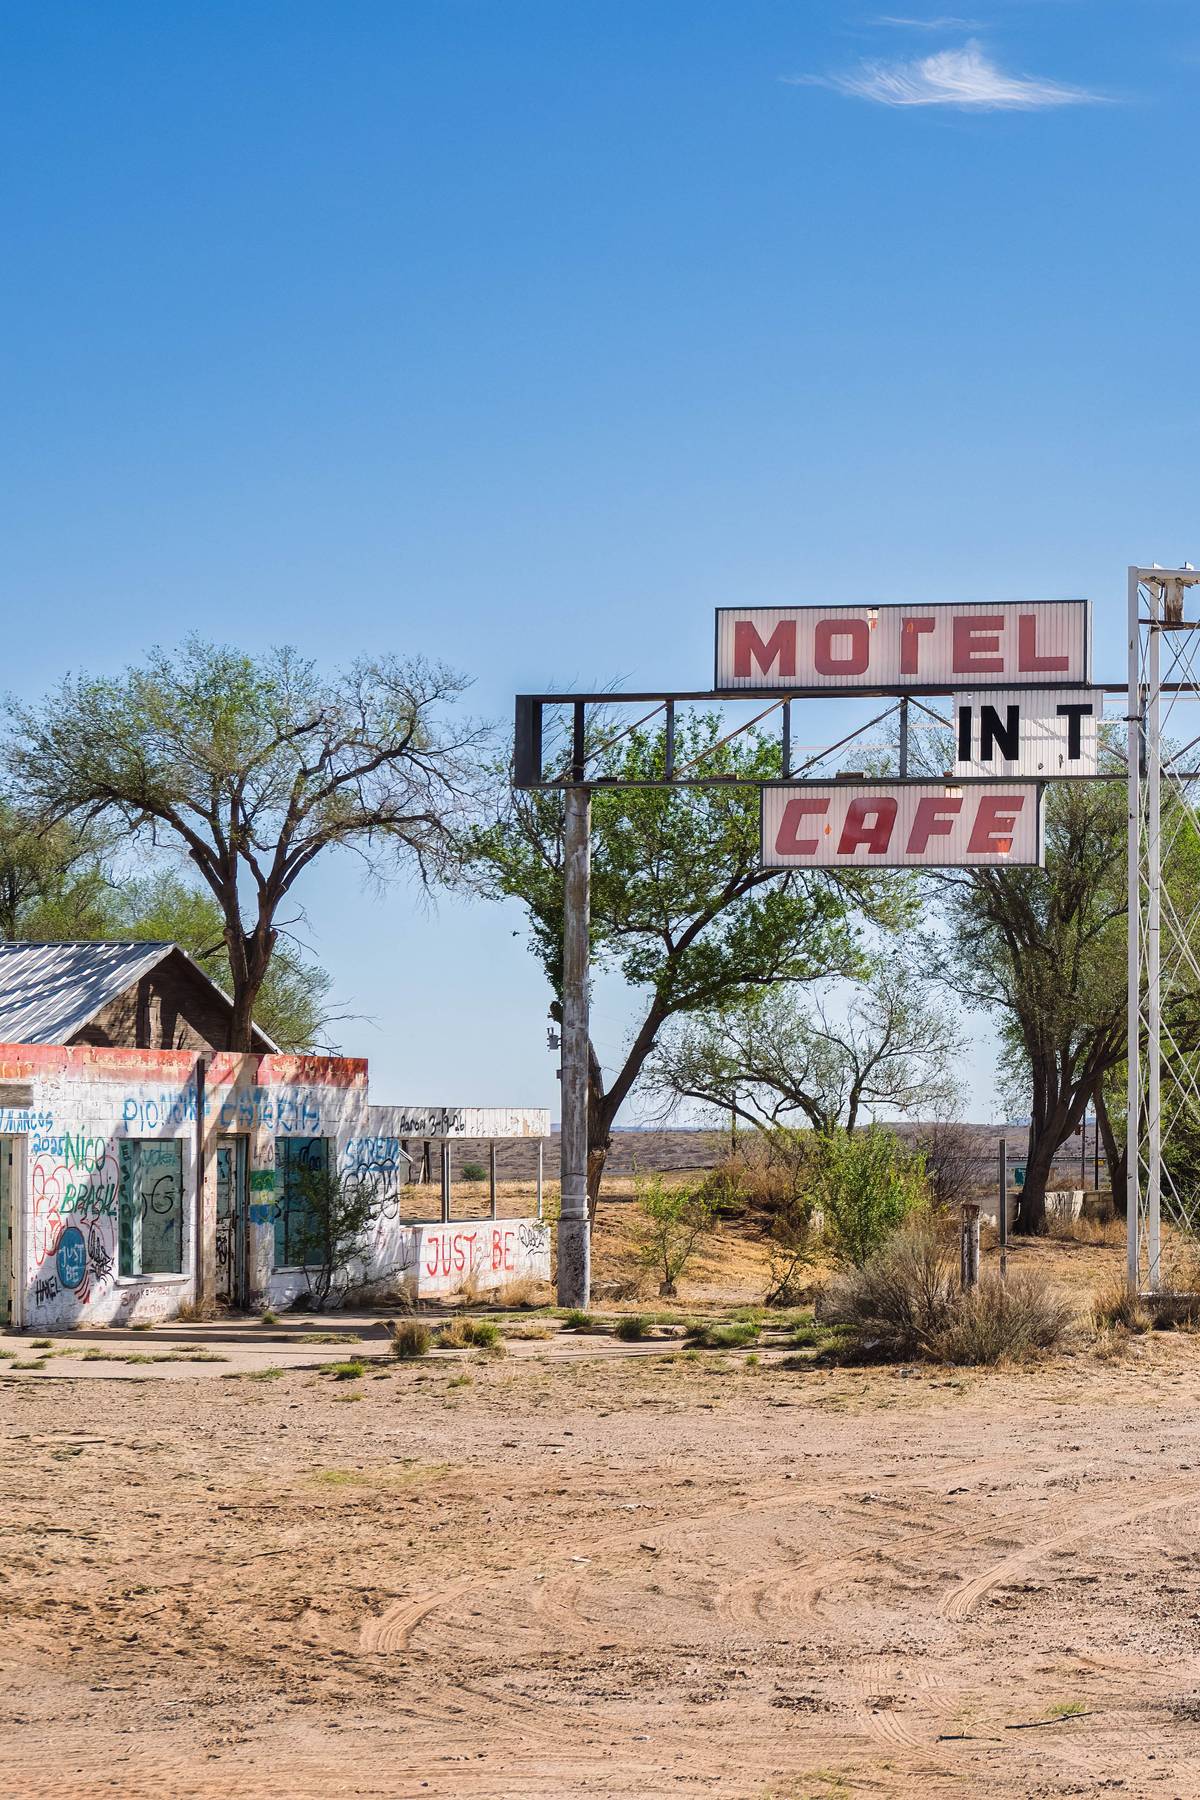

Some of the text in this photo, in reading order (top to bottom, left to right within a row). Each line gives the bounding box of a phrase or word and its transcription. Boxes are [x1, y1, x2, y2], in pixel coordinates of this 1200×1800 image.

[734, 614, 1069, 677] MOTEL
[959, 703, 1093, 761] IN T
[775, 796, 1025, 856] CAFE
[58, 1243, 84, 1267] JUST
[427, 1232, 477, 1276] JUST
[491, 1229, 515, 1271] BE
